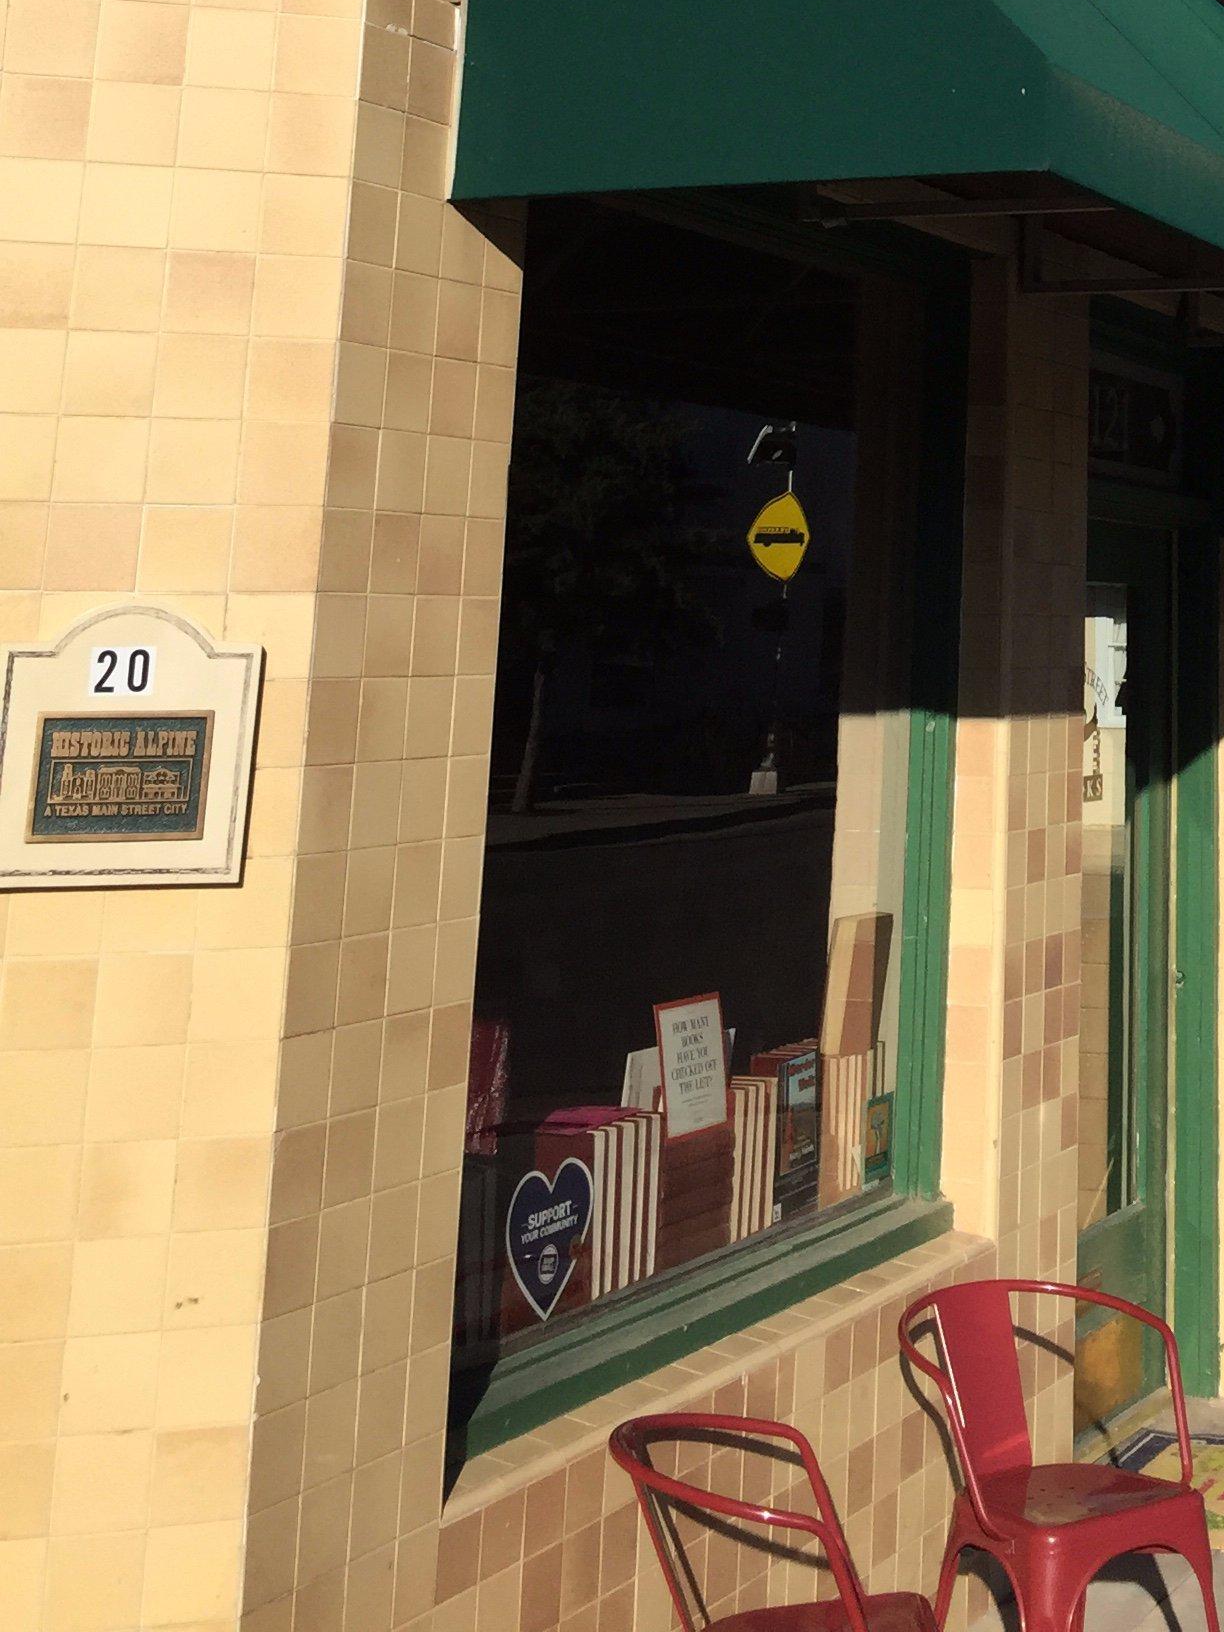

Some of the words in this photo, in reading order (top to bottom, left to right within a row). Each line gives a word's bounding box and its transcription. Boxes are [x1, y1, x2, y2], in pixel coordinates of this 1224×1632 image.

[94, 649, 150, 693] 20
[51, 731, 131, 757] HISTORIC
[134, 730, 198, 756] ALPINE
[44, 805, 52, 816] A
[55, 805, 89, 816] TEXAS
[92, 804, 119, 816] MAIN
[121, 804, 160, 815] STREET
[164, 803, 188, 814] CITY
[521, 1229, 540, 1245] YOUR
[540, 1214, 579, 1238] COMMUNITY
[527, 1199, 572, 1230] SUPPORT
